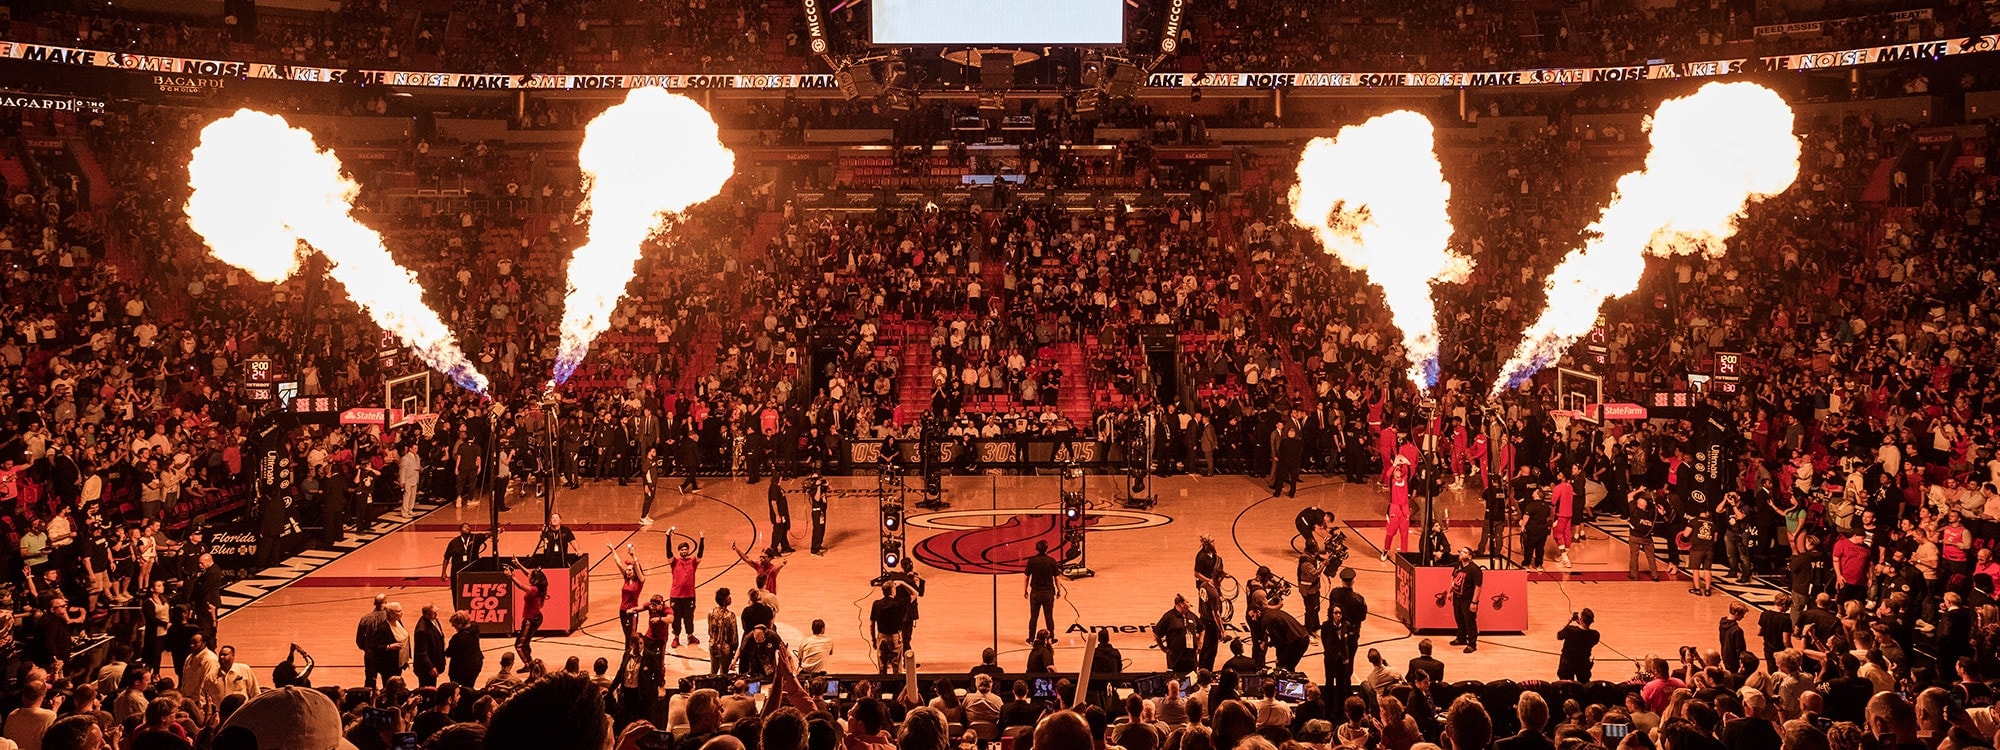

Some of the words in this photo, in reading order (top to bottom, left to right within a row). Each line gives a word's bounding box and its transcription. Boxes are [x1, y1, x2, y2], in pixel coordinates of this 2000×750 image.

[23, 46, 95, 65] MAKE
[258, 66, 320, 81] MKE
[393, 72, 450, 86] NOISE
[457, 75, 510, 89] MAKE
[573, 76, 623, 89] NOISE
[686, 76, 734, 88] SOME
[741, 76, 791, 88] NOISE
[799, 76, 838, 88] MAK
[1146, 74, 1183, 87] AKE
[1246, 74, 1296, 87] NOISE
[1303, 74, 1351, 87] MAKE
[1359, 74, 1406, 87] SOME
[1413, 74, 1462, 86] NOISE
[1470, 73, 1521, 86] MAKE
[1658, 63, 1718, 79] MKE
[1800, 51, 1867, 69] NOISE
[1877, 42, 1948, 63] MAKE
[252, 370, 266, 380] 24
[1720, 363, 1734, 373] 24
[850, 443, 881, 463] 05
[911, 443, 953, 463] 35
[211, 532, 256, 543] Florida
[210, 544, 235, 554] Blue
[462, 583, 507, 597] LET'S
[470, 596, 499, 610] GO
